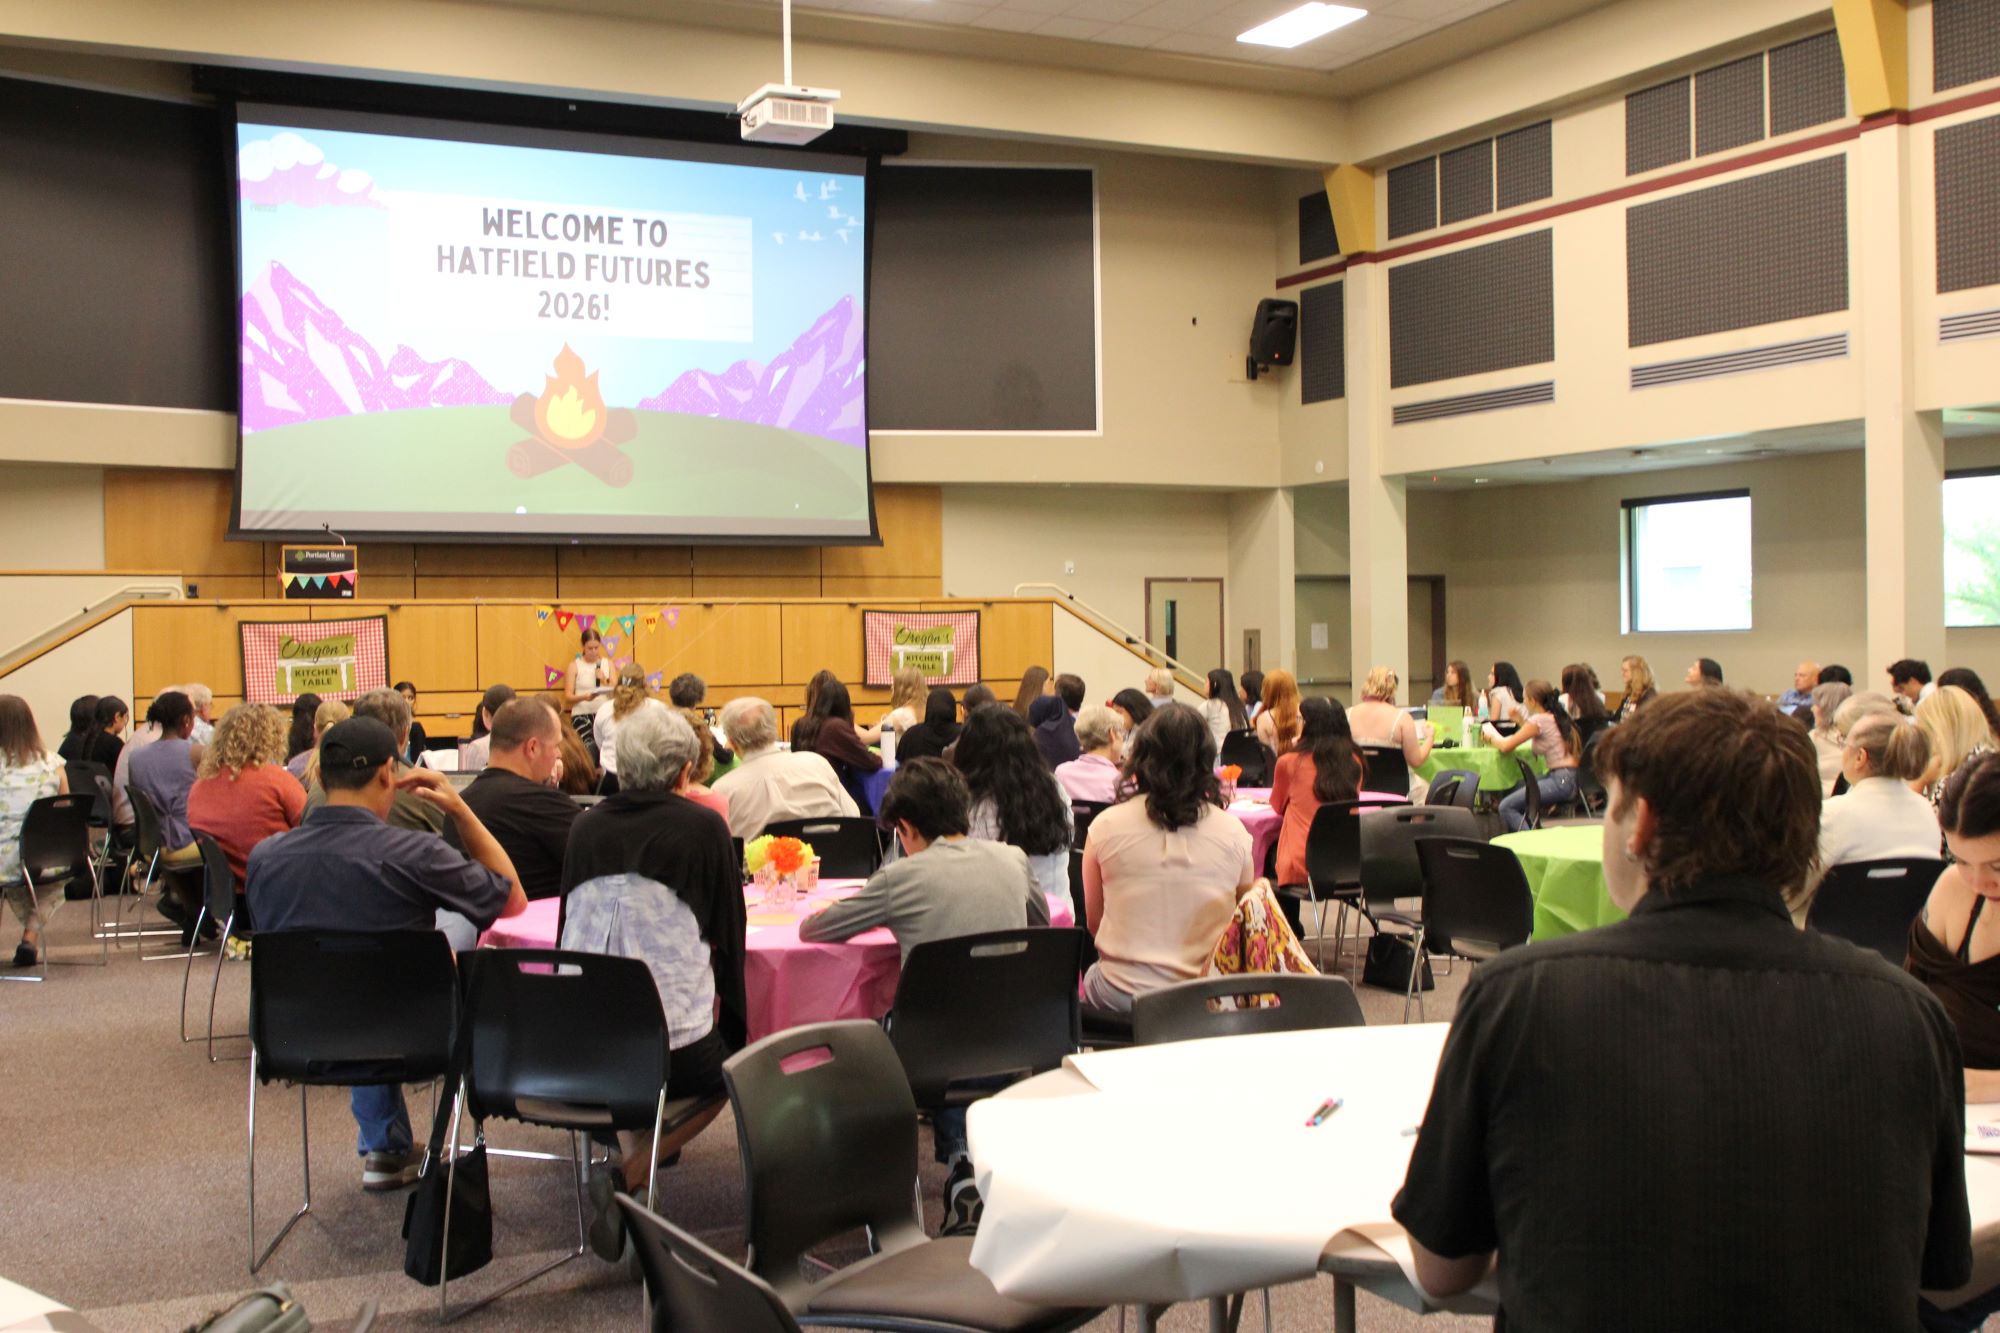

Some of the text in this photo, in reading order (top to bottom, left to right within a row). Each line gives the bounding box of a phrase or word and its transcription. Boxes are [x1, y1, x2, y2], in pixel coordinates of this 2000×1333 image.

[482, 207, 668, 248] WELCOME TO
[437, 245, 711, 289] HATFIELD FUTURES
[537, 290, 610, 321] 2026!
[305, 551, 345, 559] Portland State
[895, 627, 949, 650] Oregon's
[281, 638, 349, 664] Oregon's
[295, 668, 338, 677] KITCHEN
[303, 678, 332, 686] TABLE
